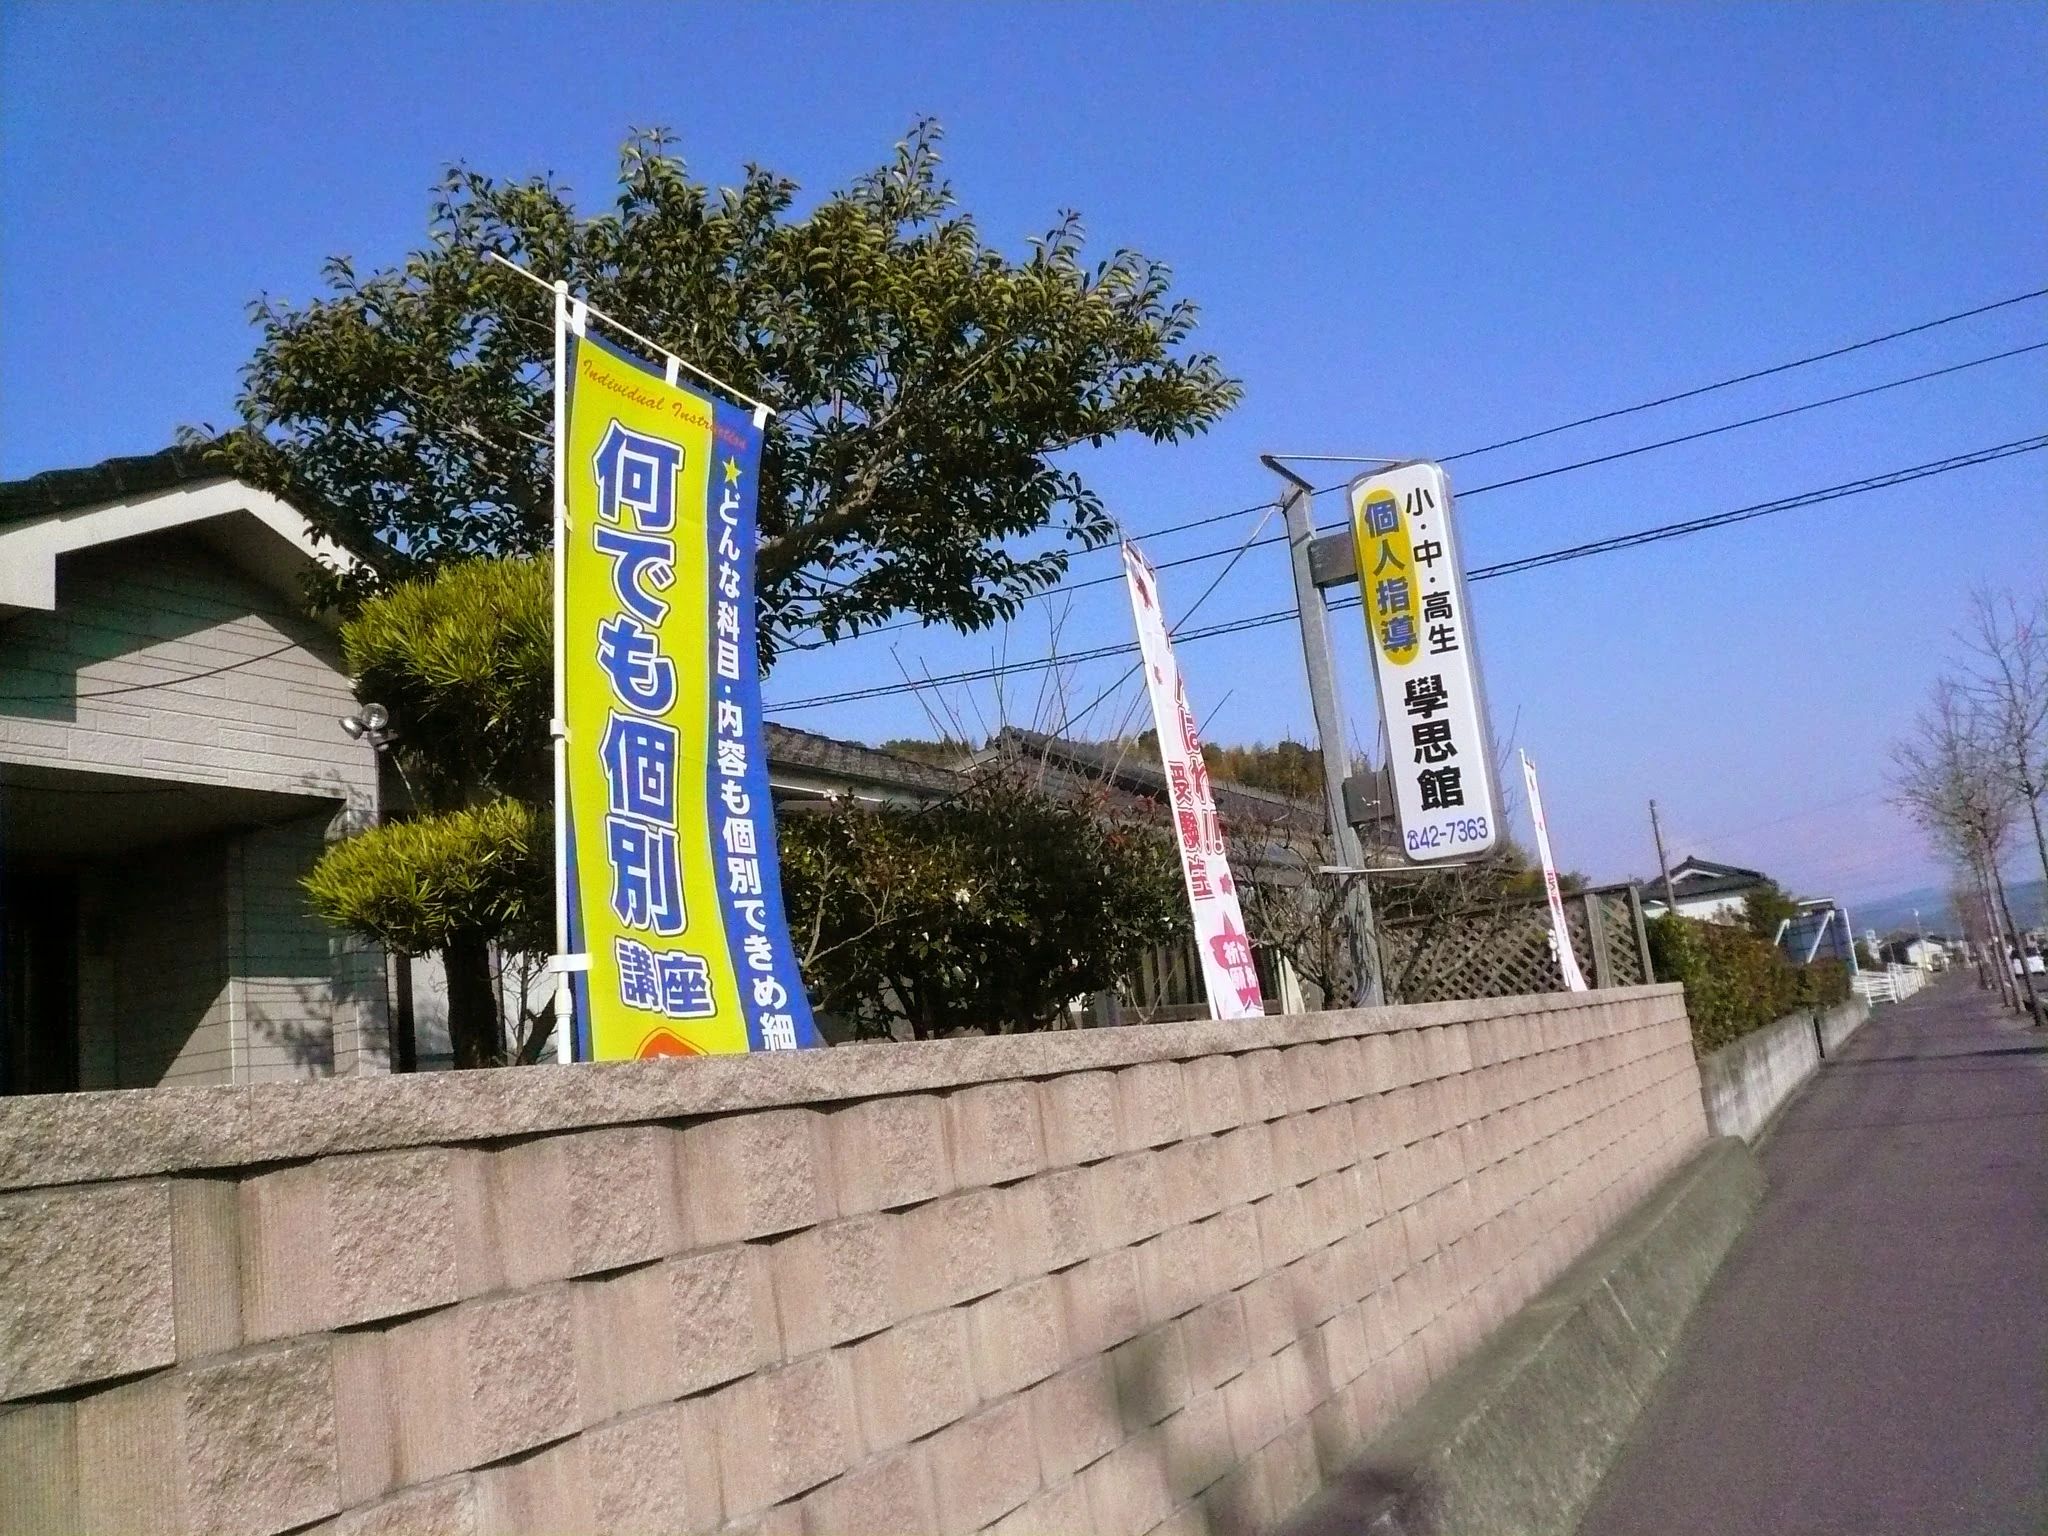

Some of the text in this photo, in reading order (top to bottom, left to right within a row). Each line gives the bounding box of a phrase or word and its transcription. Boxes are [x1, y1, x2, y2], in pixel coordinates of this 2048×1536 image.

[583, 359, 664, 411] Individual
[1364, 500, 1418, 655] 個人指導
[592, 417, 688, 937] 何でも個別
[1404, 673, 1465, 812] 學思館
[614, 937, 717, 1019] 講座
